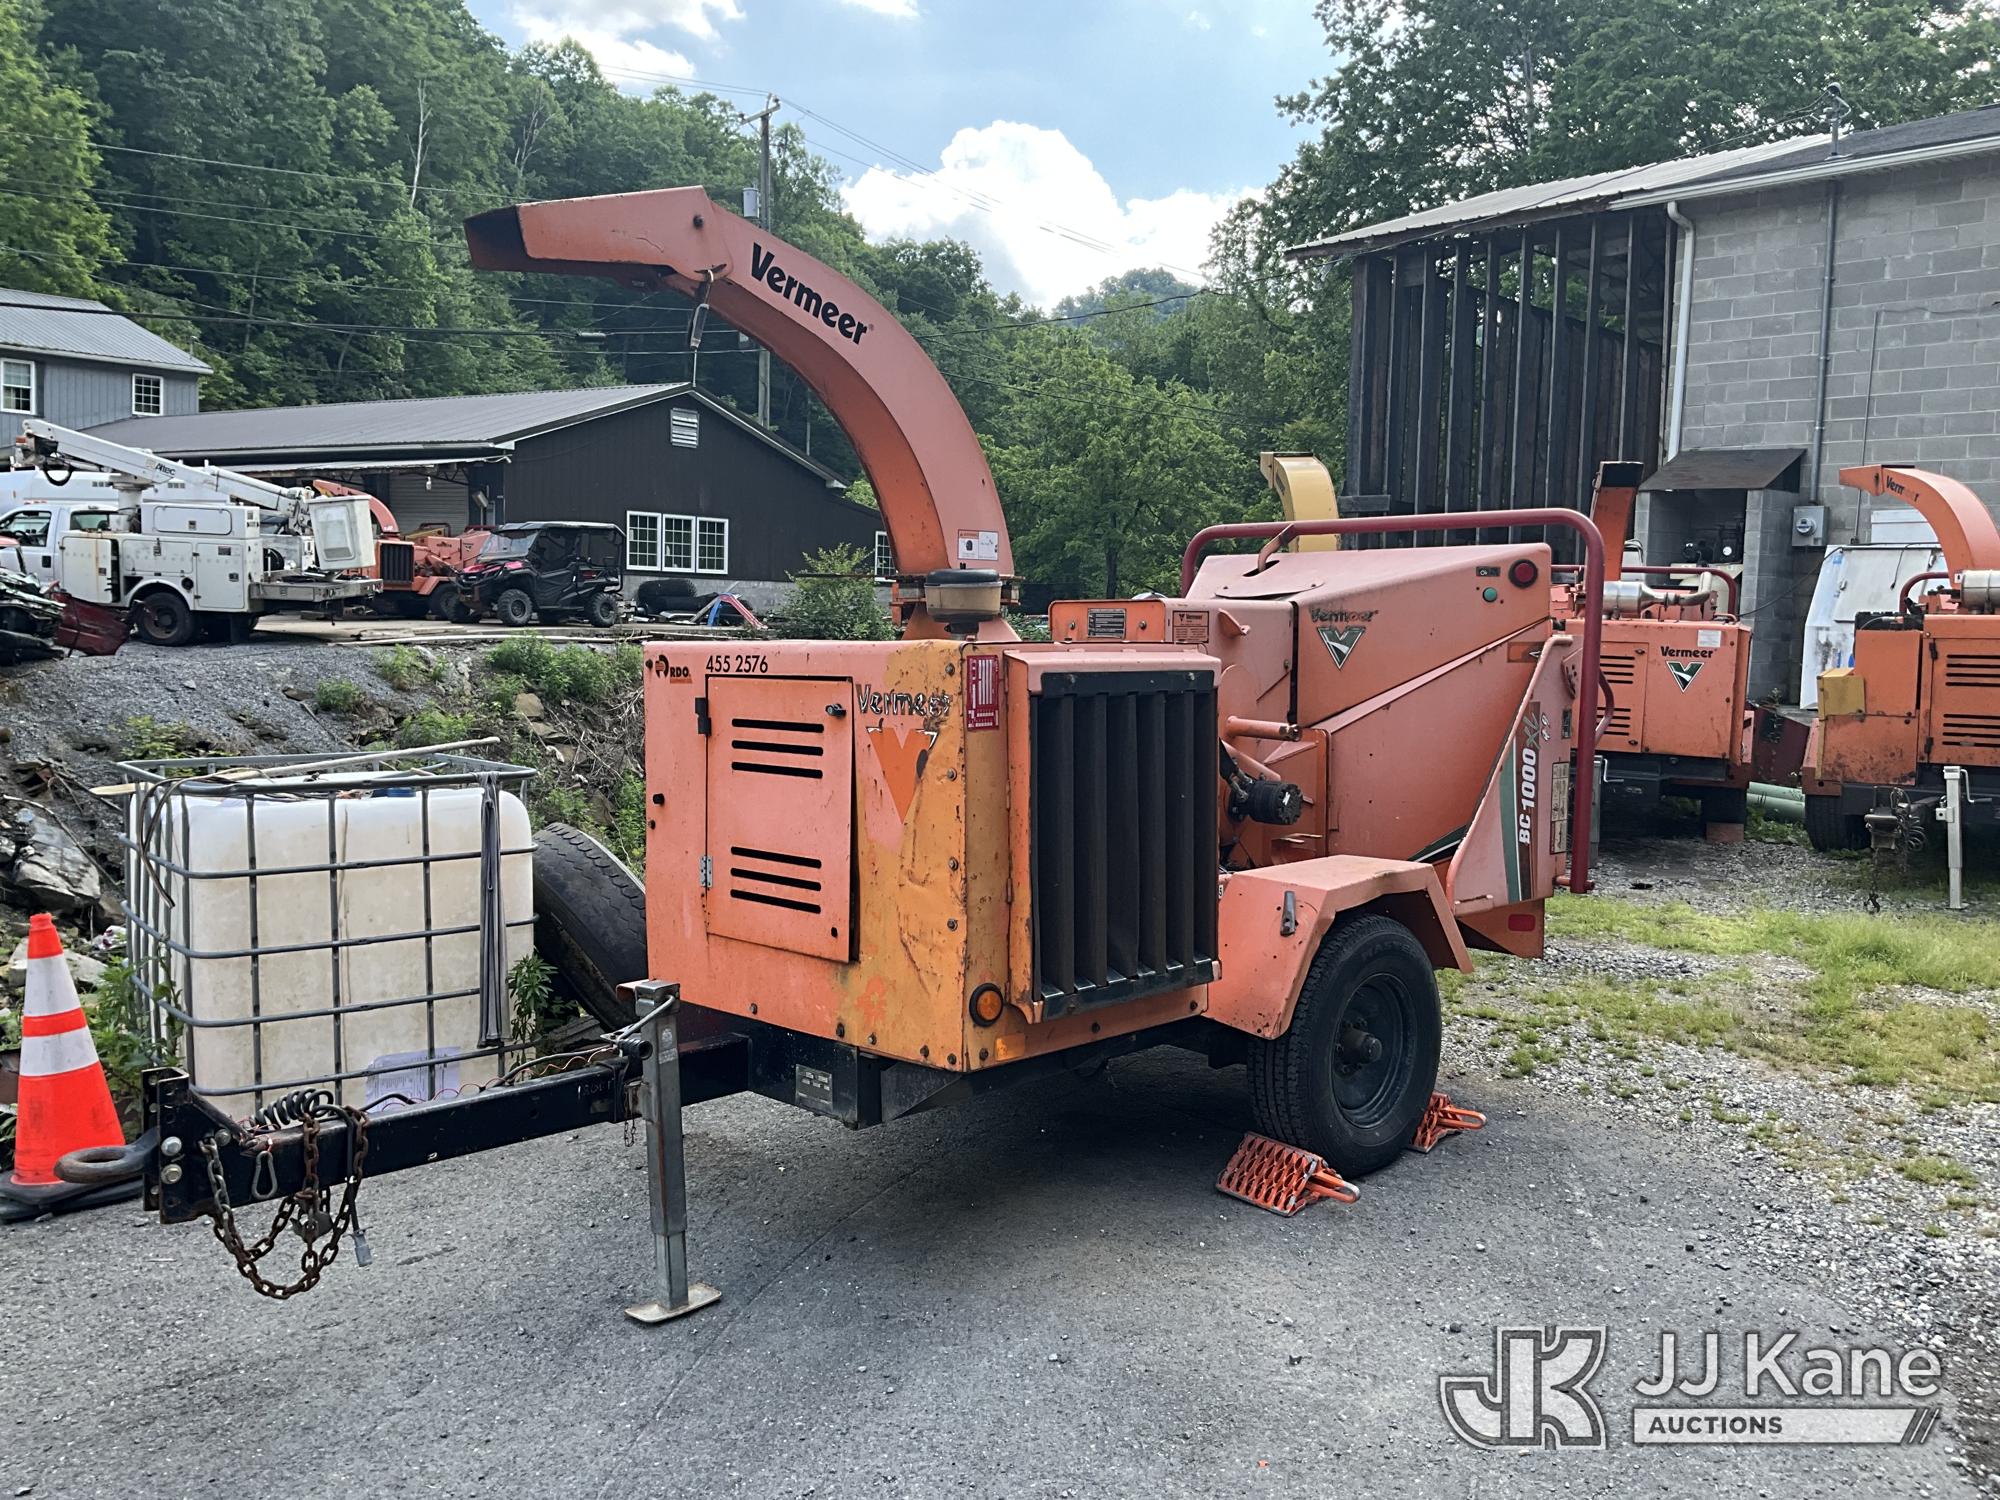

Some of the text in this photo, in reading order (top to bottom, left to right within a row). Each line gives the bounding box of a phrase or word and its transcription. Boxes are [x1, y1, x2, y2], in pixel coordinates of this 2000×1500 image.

[751, 242, 867, 345] Vermeer
[155, 462, 176, 476] Altec
[1660, 645, 1713, 658] Vermeer
[706, 654, 769, 673] 455 2576
[669, 666, 689, 678] RDO
[1518, 813, 1531, 845] BC
